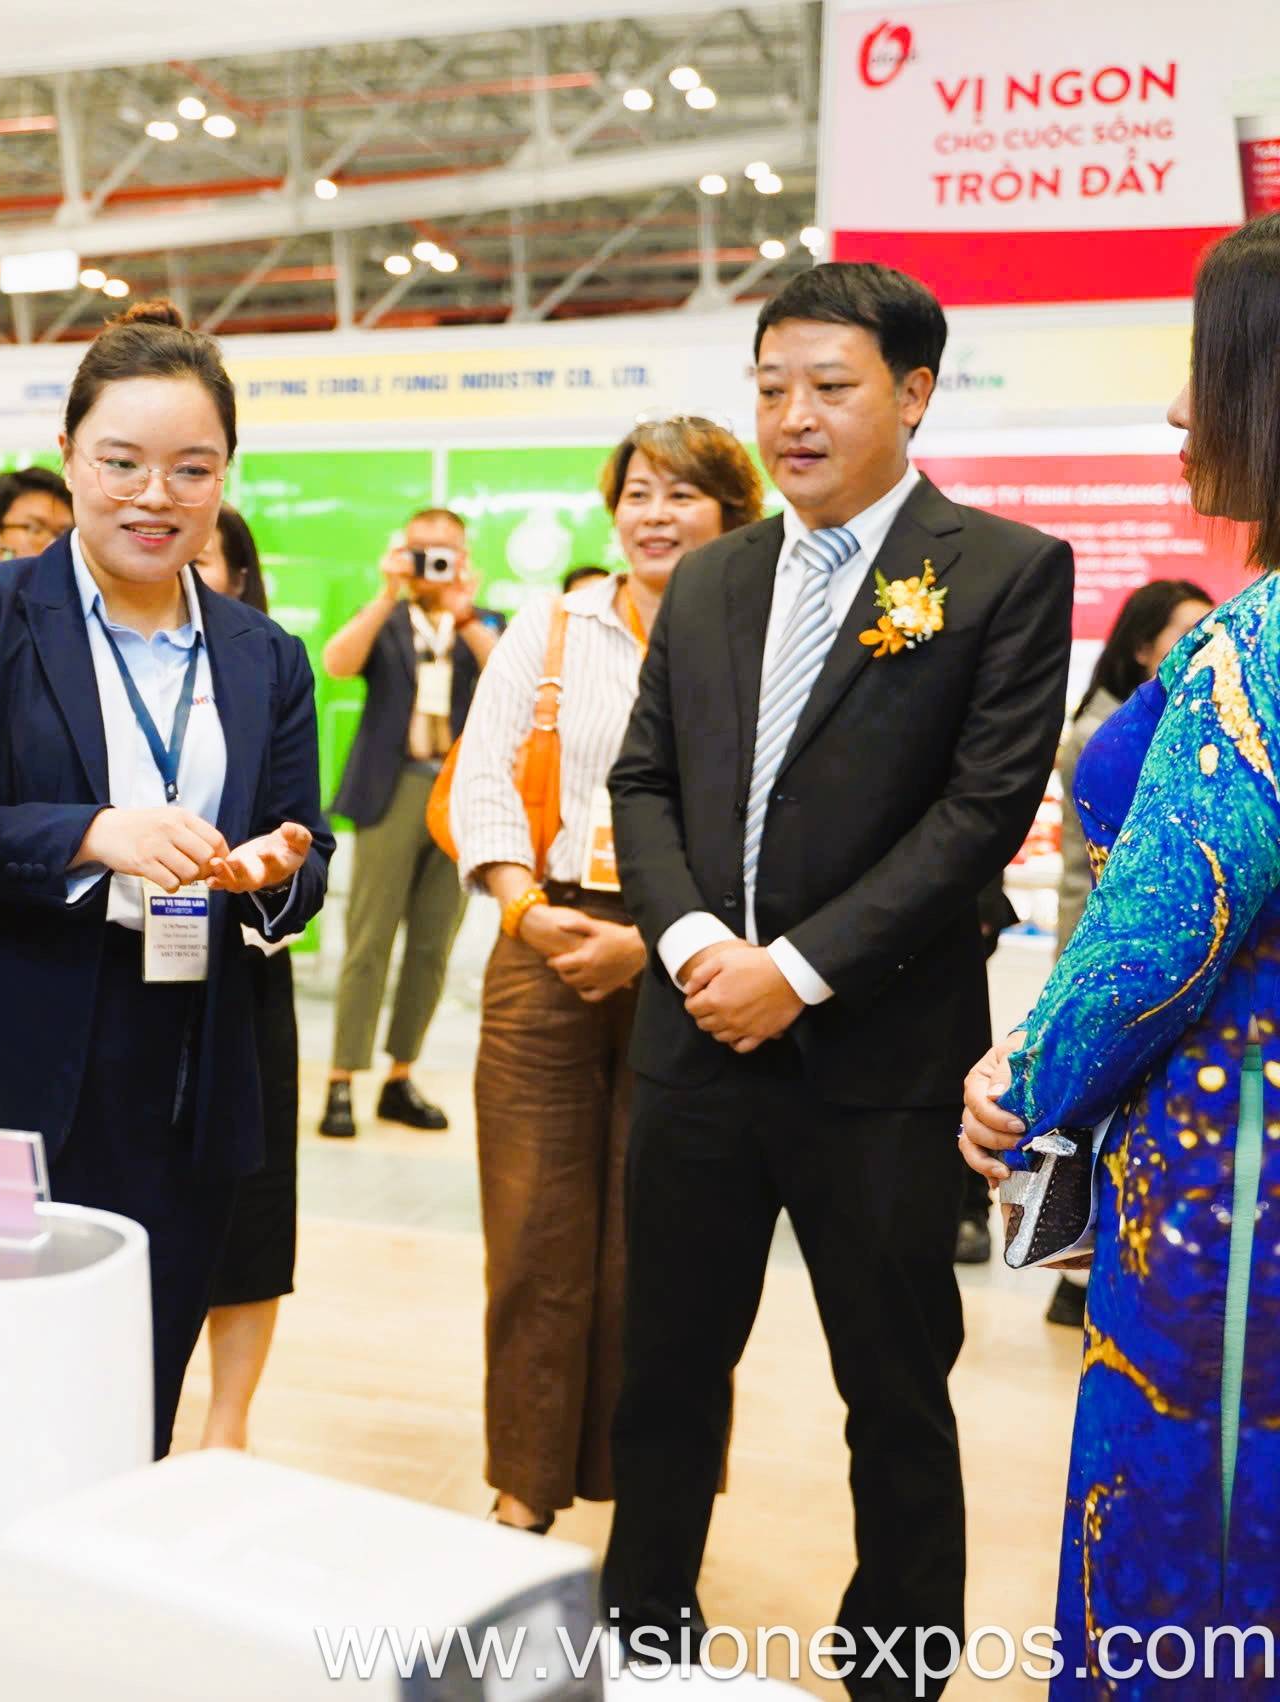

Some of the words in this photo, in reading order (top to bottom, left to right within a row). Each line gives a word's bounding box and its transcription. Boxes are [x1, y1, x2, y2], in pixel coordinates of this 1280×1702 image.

[935, 77, 985, 123] VỊ
[1006, 61, 1177, 112] NGON
[934, 130, 996, 155] CHO
[931, 160, 1060, 206] TRÒN
